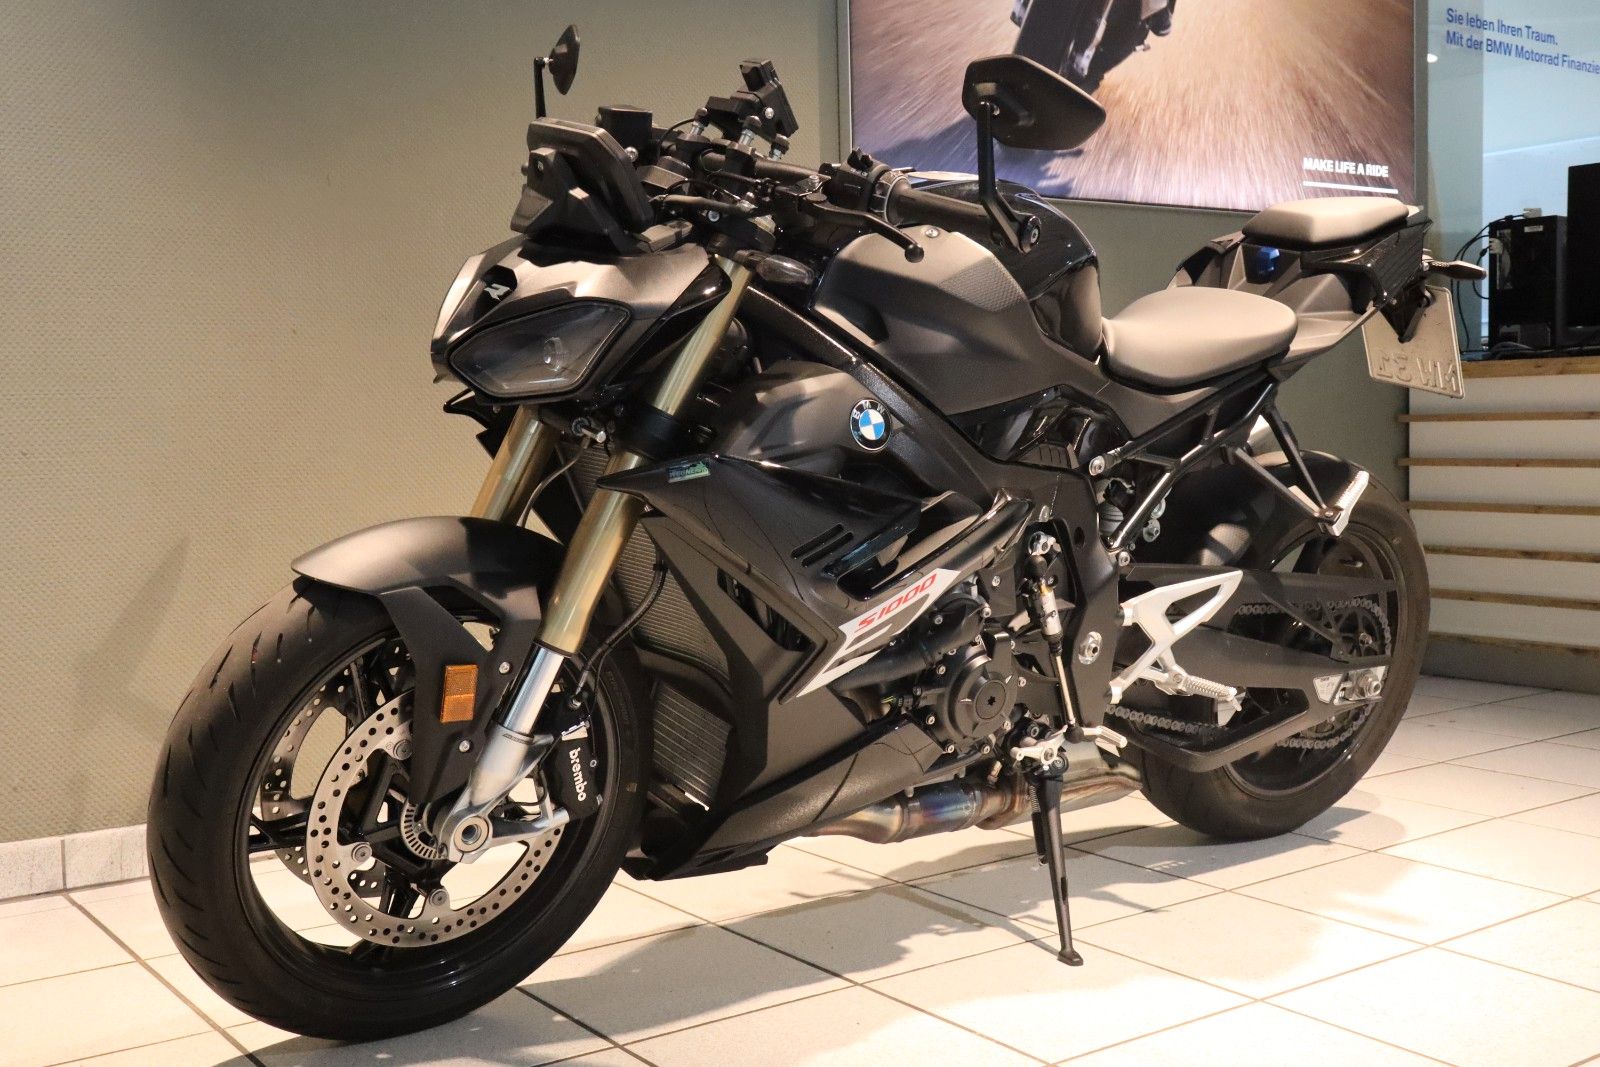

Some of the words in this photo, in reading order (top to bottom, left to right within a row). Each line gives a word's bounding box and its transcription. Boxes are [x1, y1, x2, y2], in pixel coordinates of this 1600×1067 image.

[1446, 8, 1463, 25] Sie
[1466, 12, 1495, 32] leben
[1497, 19, 1523, 38] Ihren
[1525, 25, 1558, 46] Traum.
[1446, 30, 1464, 47] Mit
[1466, 35, 1483, 51] der
[1486, 38, 1513, 57] BMW
[1515, 46, 1560, 67] Motorrad
[1303, 157, 1334, 172] MAKE
[1334, 160, 1356, 174] LIFE
[1357, 163, 1365, 176] A
[1365, 163, 1389, 178] RIDE
[569, 747, 588, 802] brembo
